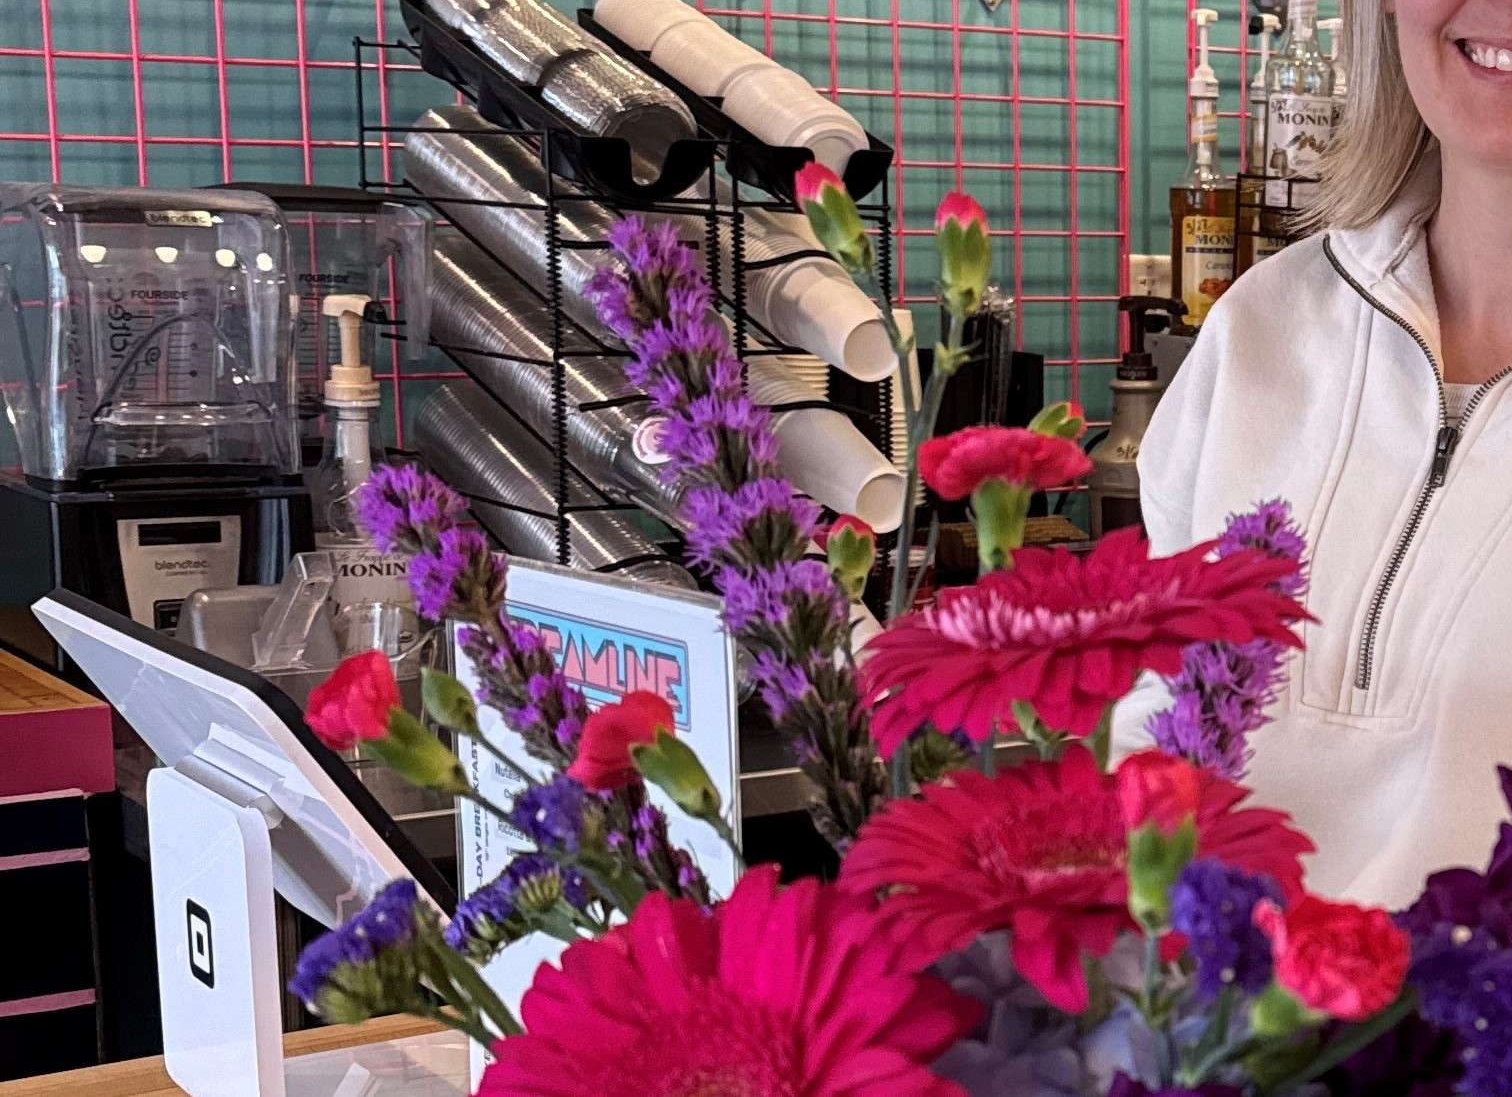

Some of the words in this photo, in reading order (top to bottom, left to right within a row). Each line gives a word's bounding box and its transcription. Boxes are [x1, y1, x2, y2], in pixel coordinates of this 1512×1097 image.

[1195, 234, 1234, 246] MON
[131, 289, 189, 301] FOURSIDE
[510, 618, 683, 714] EAMLINE
[471, 741, 481, 837] BREKFAST
[475, 842, 483, 884] -DAY
